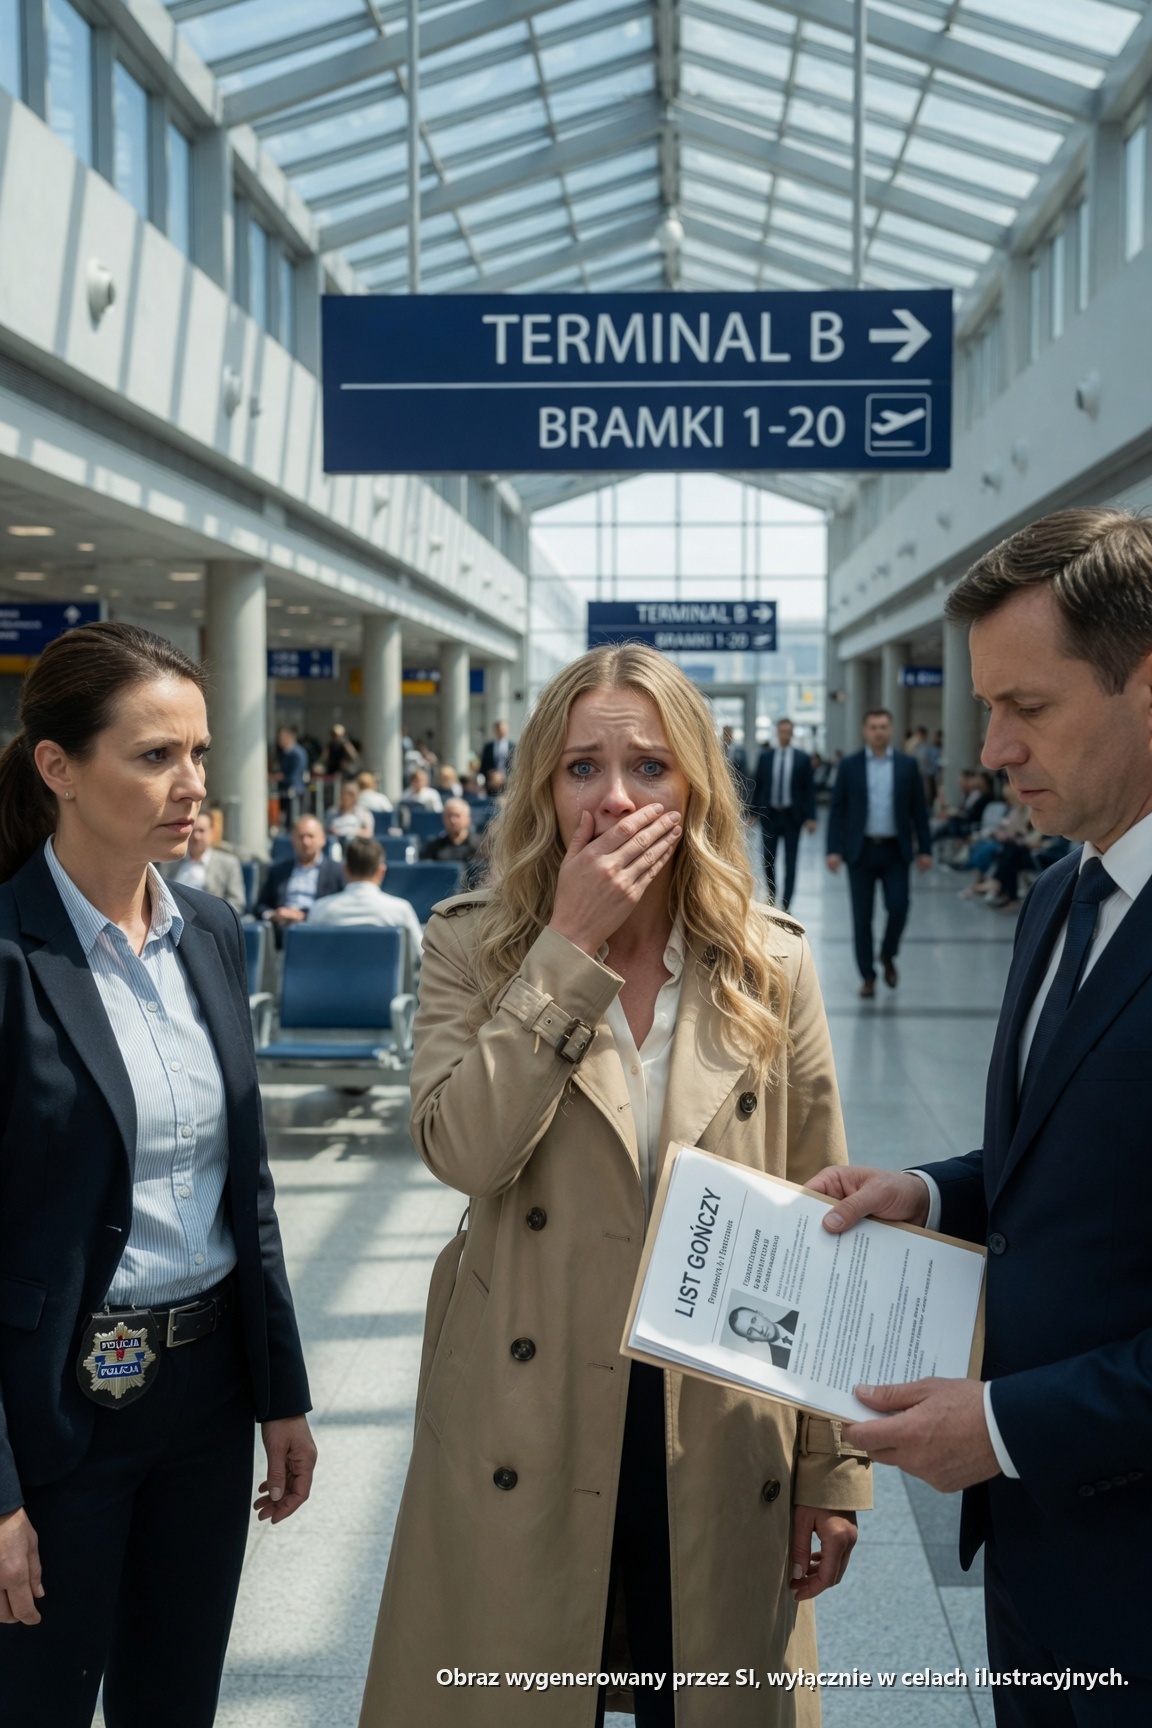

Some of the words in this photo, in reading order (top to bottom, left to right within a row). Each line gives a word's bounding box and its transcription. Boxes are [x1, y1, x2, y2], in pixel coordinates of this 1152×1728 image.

[482, 311, 791, 365] TERMINAL
[810, 311, 846, 364] B
[538, 405, 724, 450] BRAMKI
[743, 405, 847, 448] 1-20
[636, 603, 731, 625] TERMINAL
[733, 604, 748, 625] B
[687, 1187, 721, 1270] GOŃCZY
[675, 1271, 701, 1318] LIST
